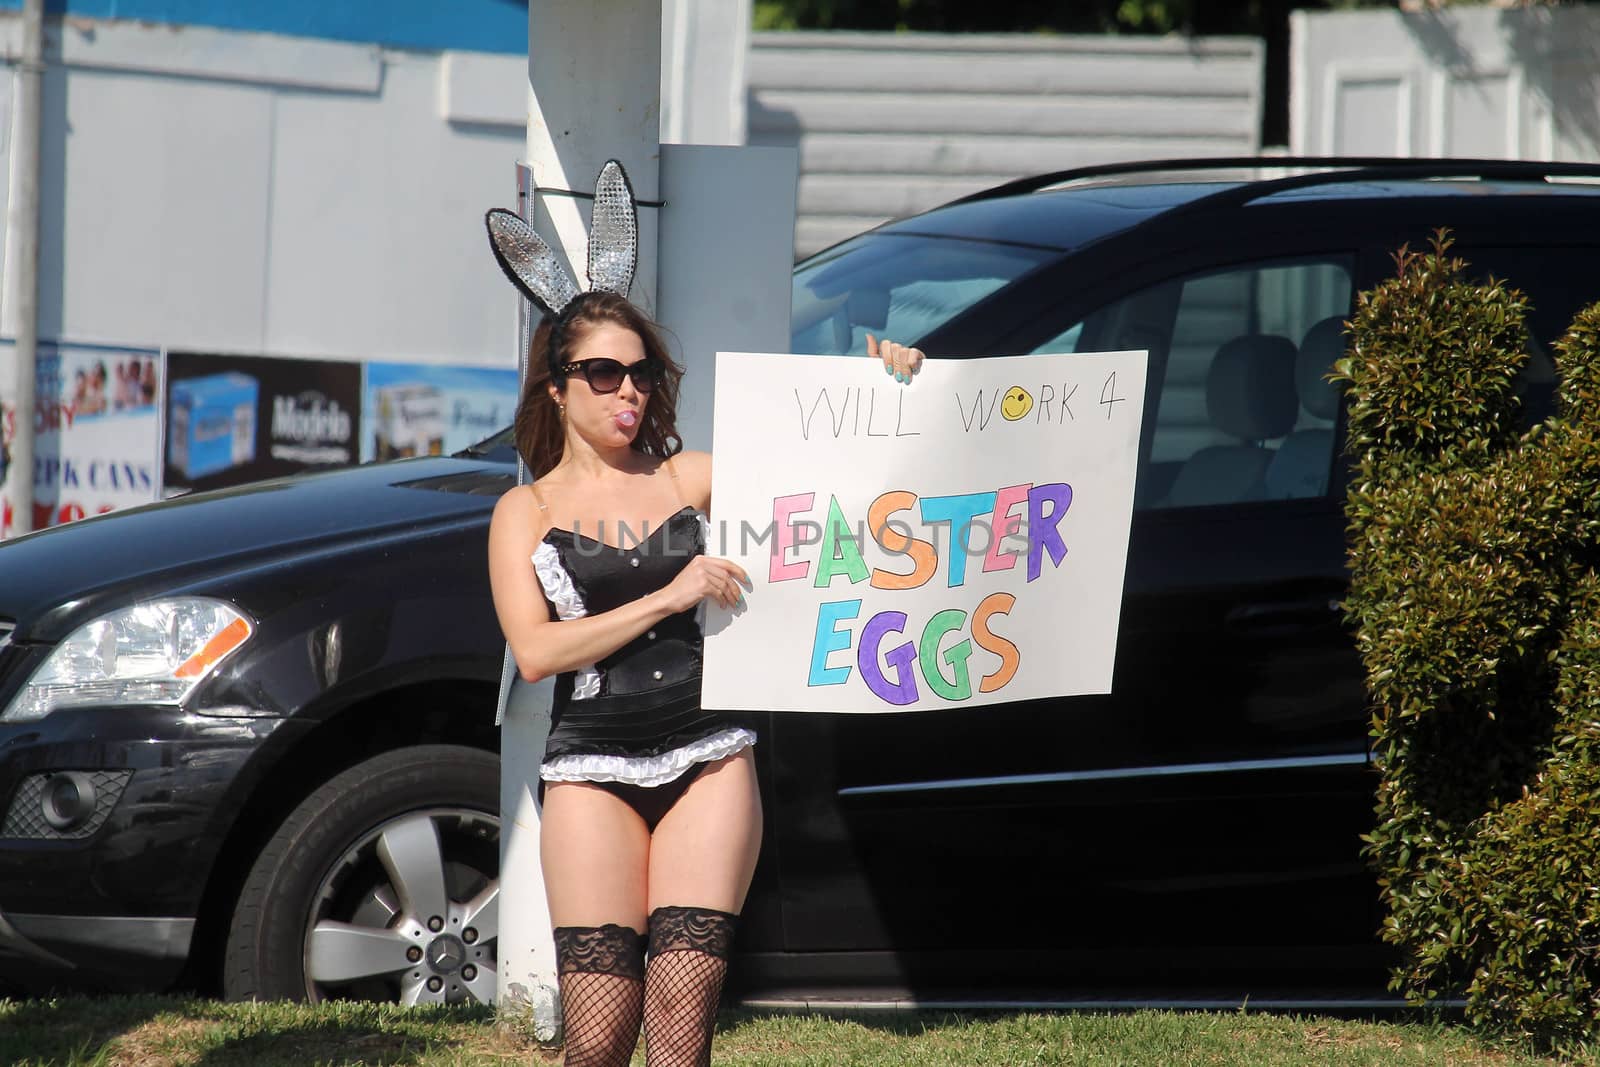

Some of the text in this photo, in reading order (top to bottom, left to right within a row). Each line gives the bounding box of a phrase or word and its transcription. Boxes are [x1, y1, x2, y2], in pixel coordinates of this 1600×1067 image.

[794, 386, 921, 441] WILL
[1099, 371, 1126, 421] 4
[768, 482, 1073, 590] EASTER
[807, 592, 1021, 706] EGGS
